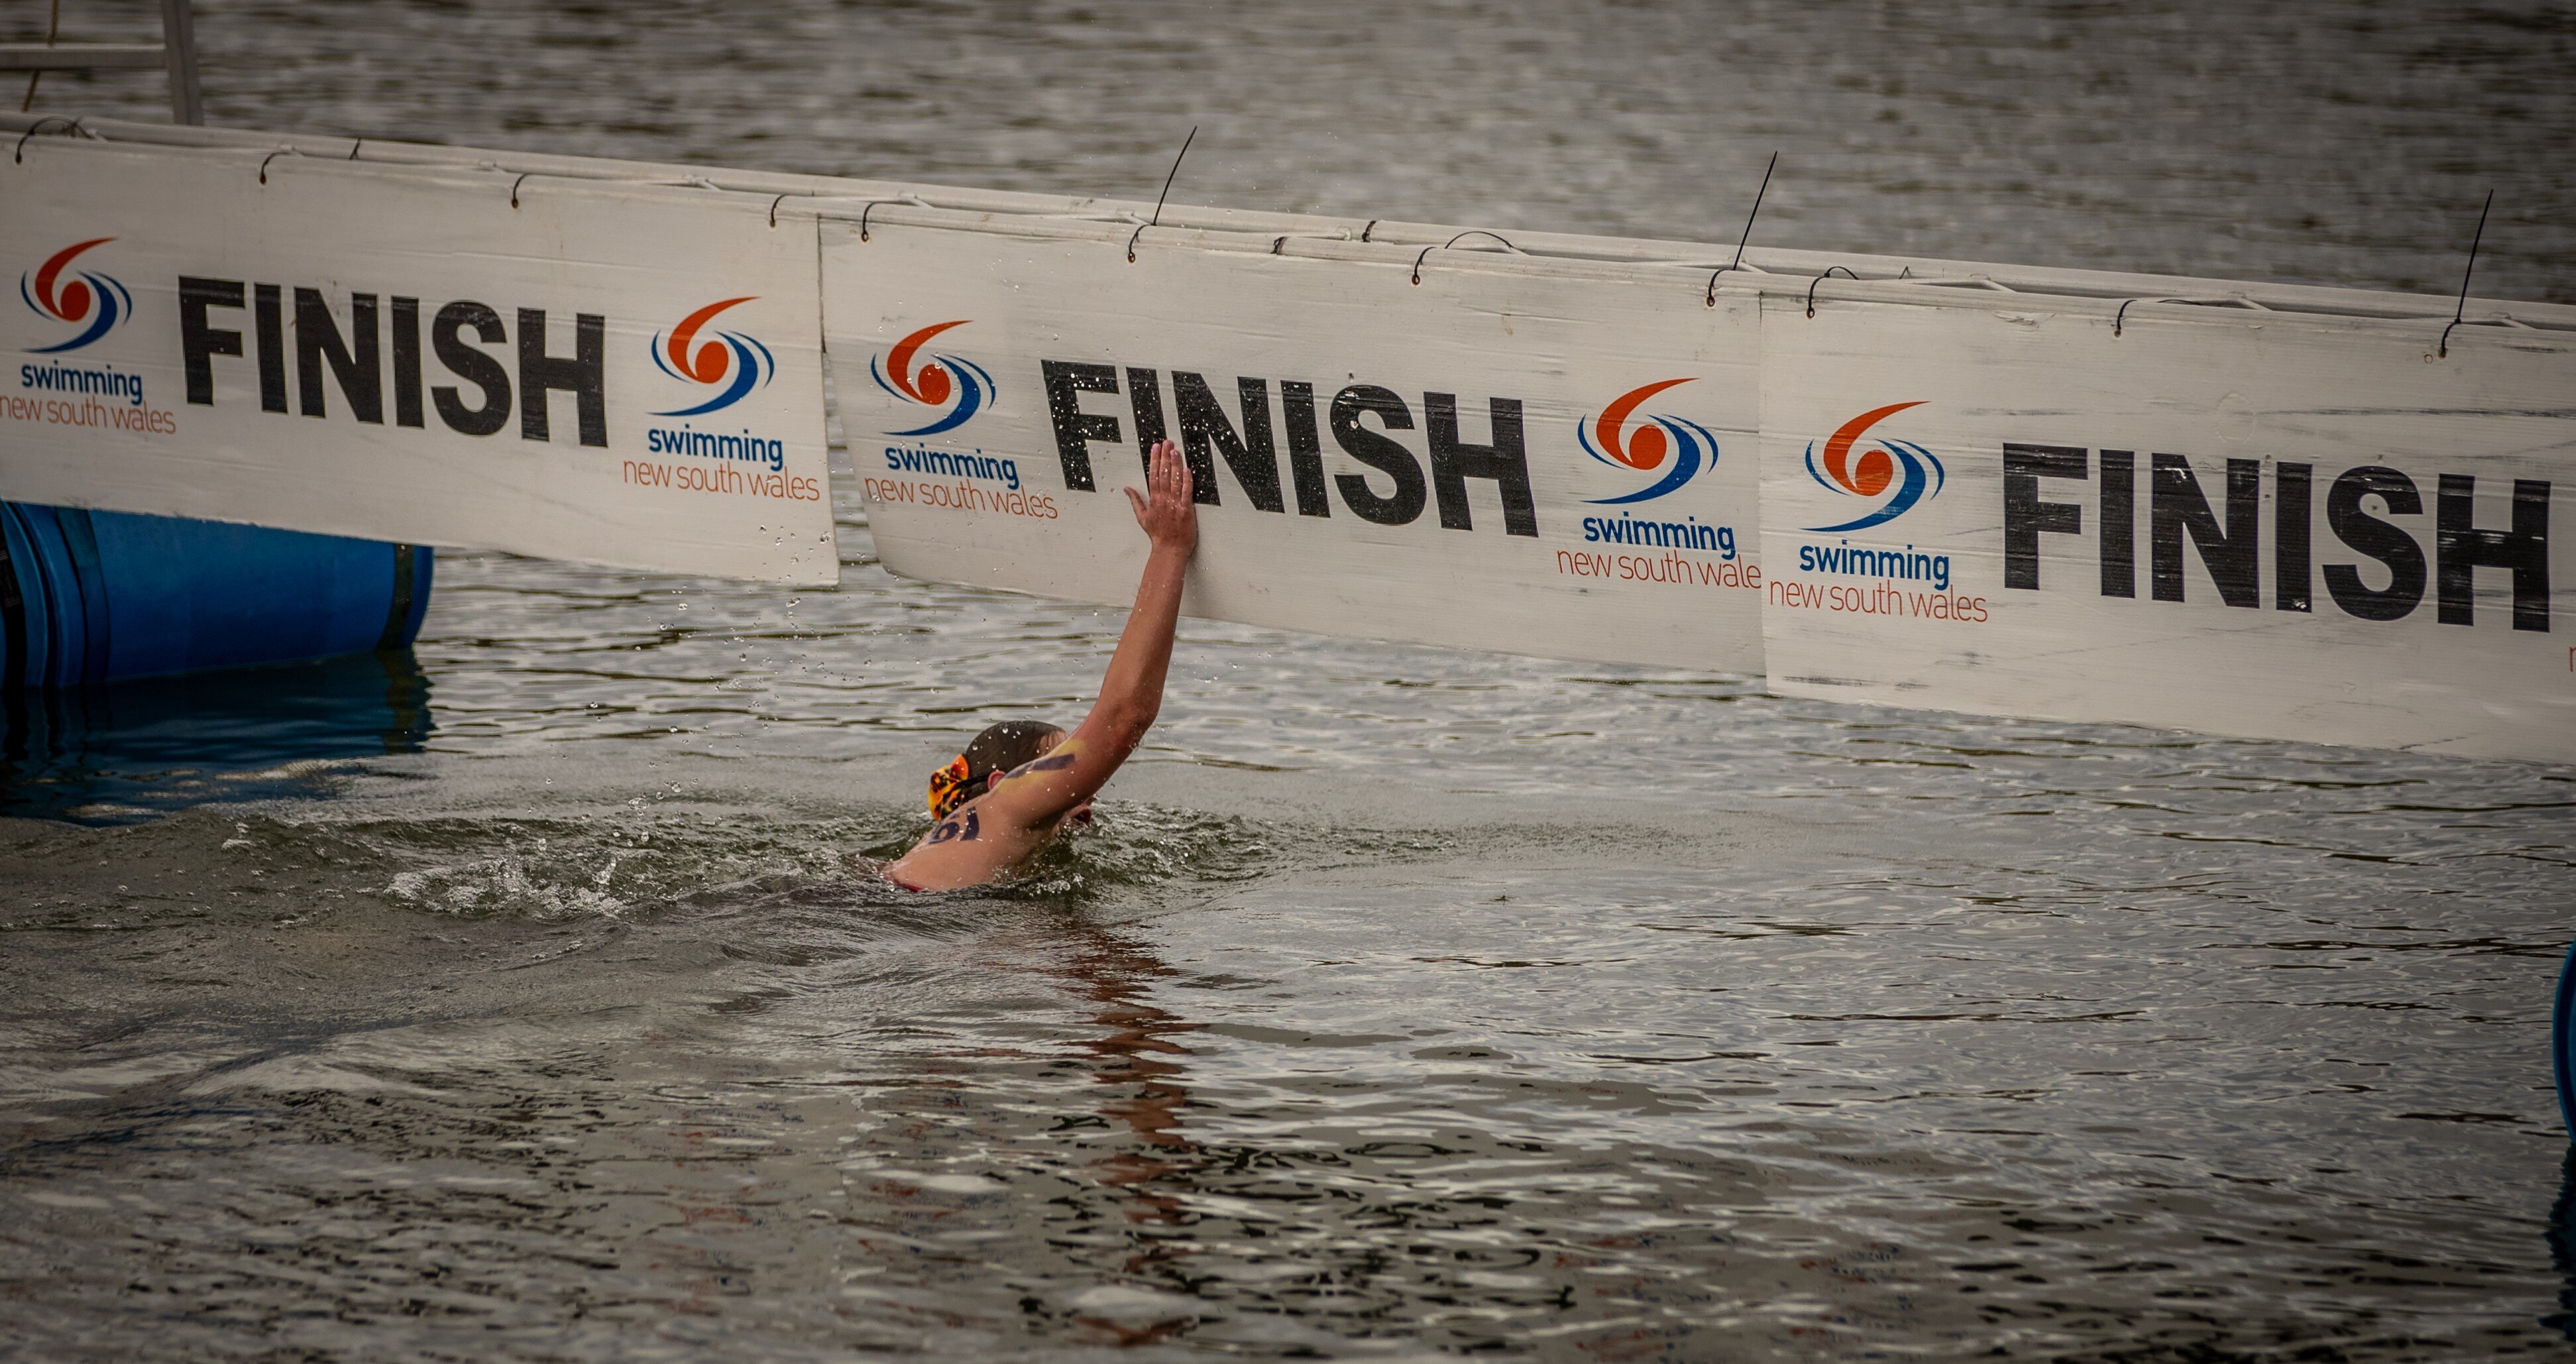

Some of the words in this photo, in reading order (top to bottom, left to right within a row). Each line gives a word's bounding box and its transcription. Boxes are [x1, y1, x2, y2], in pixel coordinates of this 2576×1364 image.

[21, 359, 142, 406] swimming
[178, 275, 608, 449] FINISH
[0, 394, 42, 422] new
[46, 395, 108, 427] south
[111, 400, 177, 435] wales
[648, 424, 783, 471] swimming
[885, 443, 1019, 490] swimming
[1040, 359, 1539, 538] FINISH
[624, 460, 671, 488] new
[677, 461, 742, 494] south
[747, 466, 820, 501] wales
[864, 477, 914, 503] new
[919, 479, 985, 510] south
[987, 484, 1058, 519] wales
[1583, 511, 1736, 561] swimming
[2003, 443, 2551, 632] FINISH
[1557, 550, 1611, 577] new
[1618, 549, 1693, 584] south
[1799, 540, 1949, 591] swimming
[1770, 581, 1824, 608] new
[1830, 580, 1902, 616] south
[1909, 585, 1988, 622] wales
